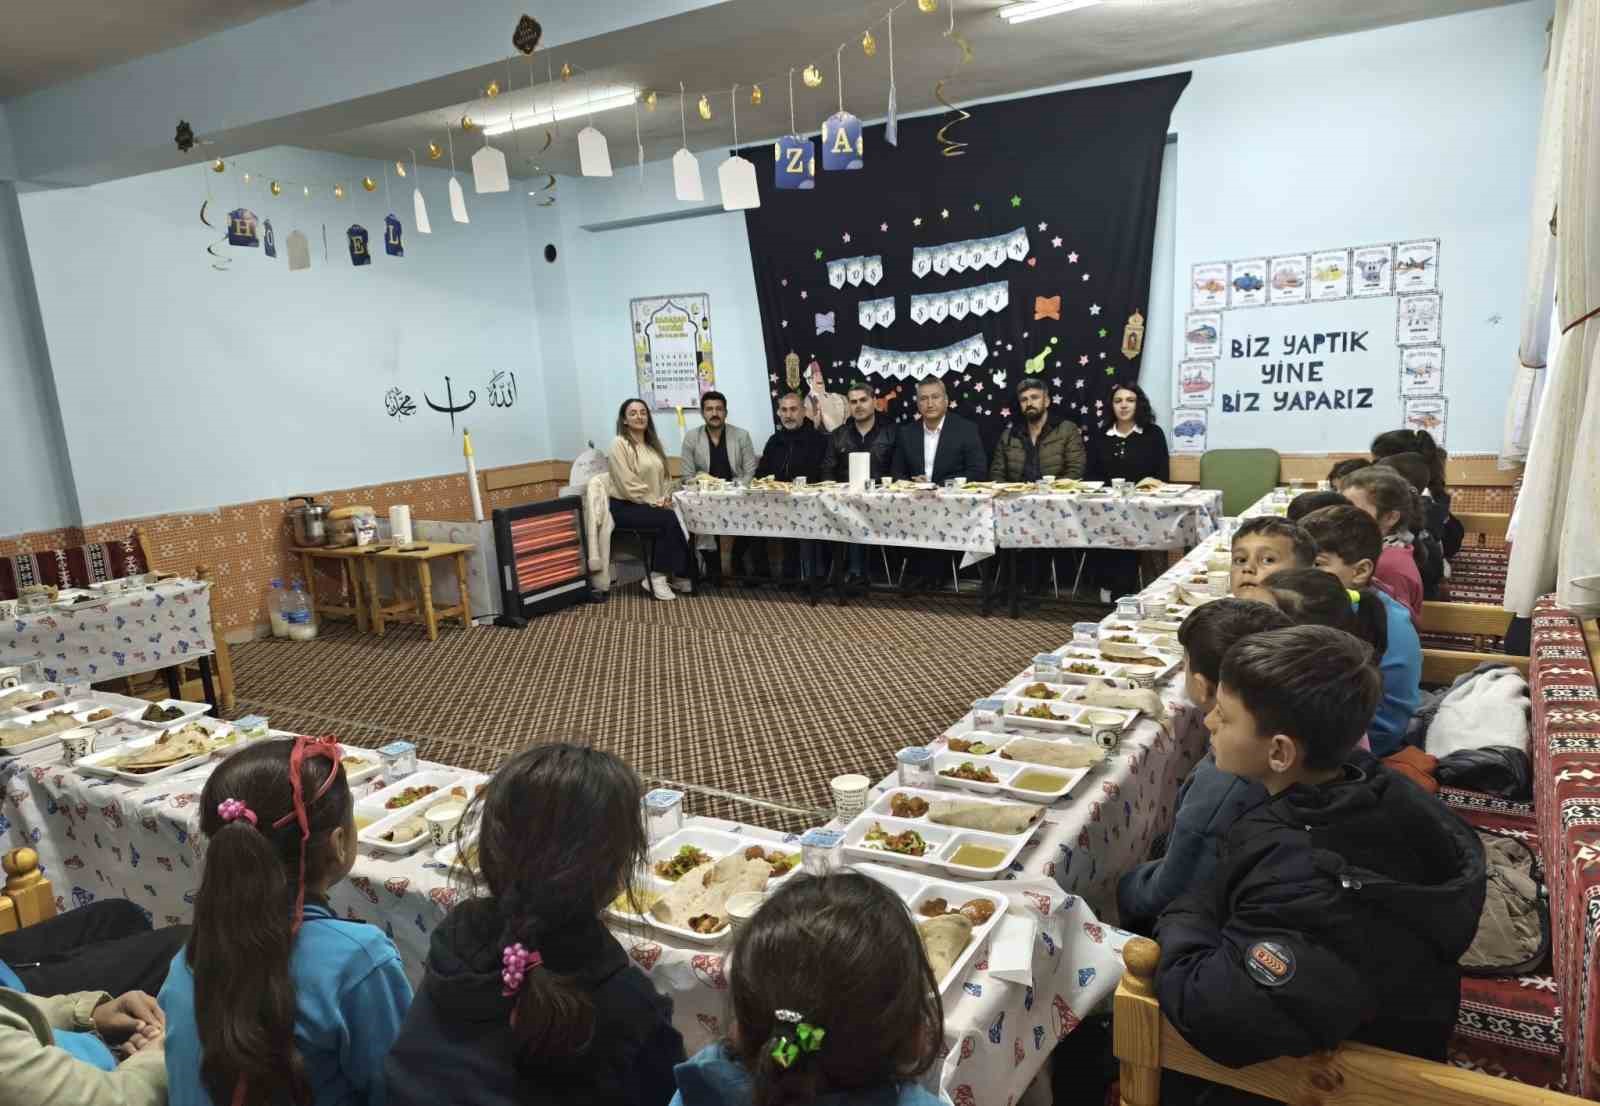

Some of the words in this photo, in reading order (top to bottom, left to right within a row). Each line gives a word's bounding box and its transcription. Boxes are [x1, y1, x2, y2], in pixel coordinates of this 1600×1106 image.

[786, 148, 804, 173] Z
[830, 127, 853, 153] A
[1231, 334, 1270, 358] BİZ
[1283, 330, 1369, 355] YAPTIK
[1261, 360, 1324, 384] YİNE
[1222, 390, 1260, 413] BİZ
[1273, 388, 1374, 411] YAPARIZ
